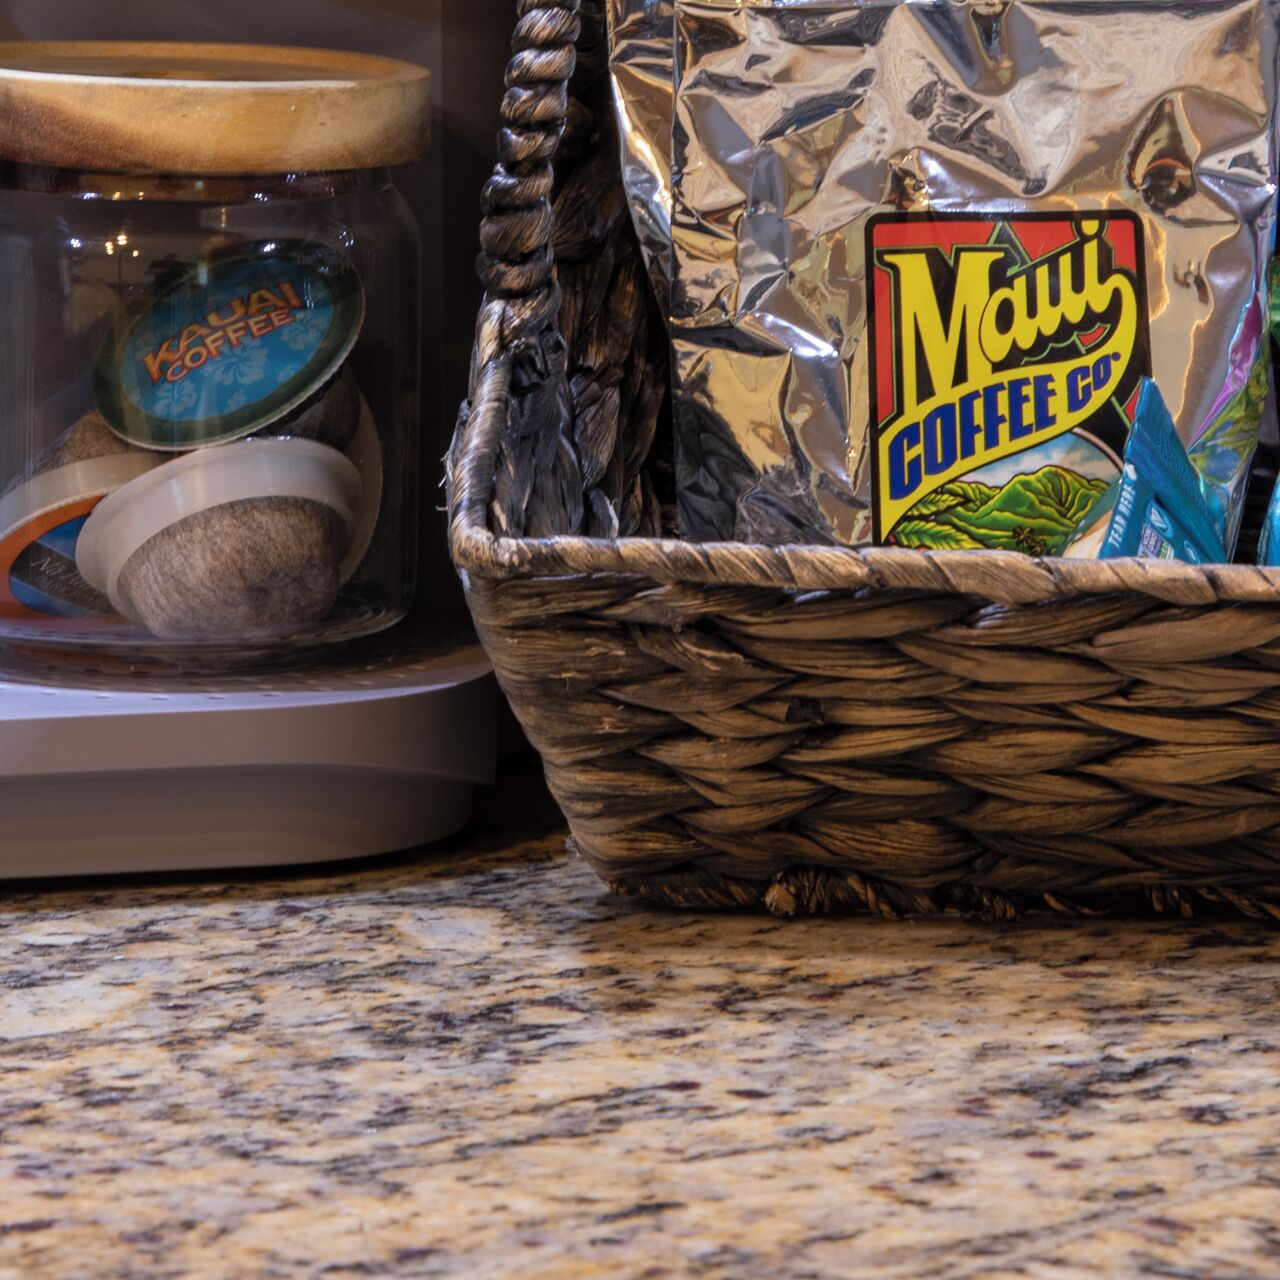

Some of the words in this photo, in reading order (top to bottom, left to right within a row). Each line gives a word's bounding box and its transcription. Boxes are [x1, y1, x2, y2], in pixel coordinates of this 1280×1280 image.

[144, 281, 303, 385] KAUAI
[166, 308, 296, 382] COFFEE
[883, 219, 1136, 414] Maui
[888, 375, 1057, 500] COFFEE
